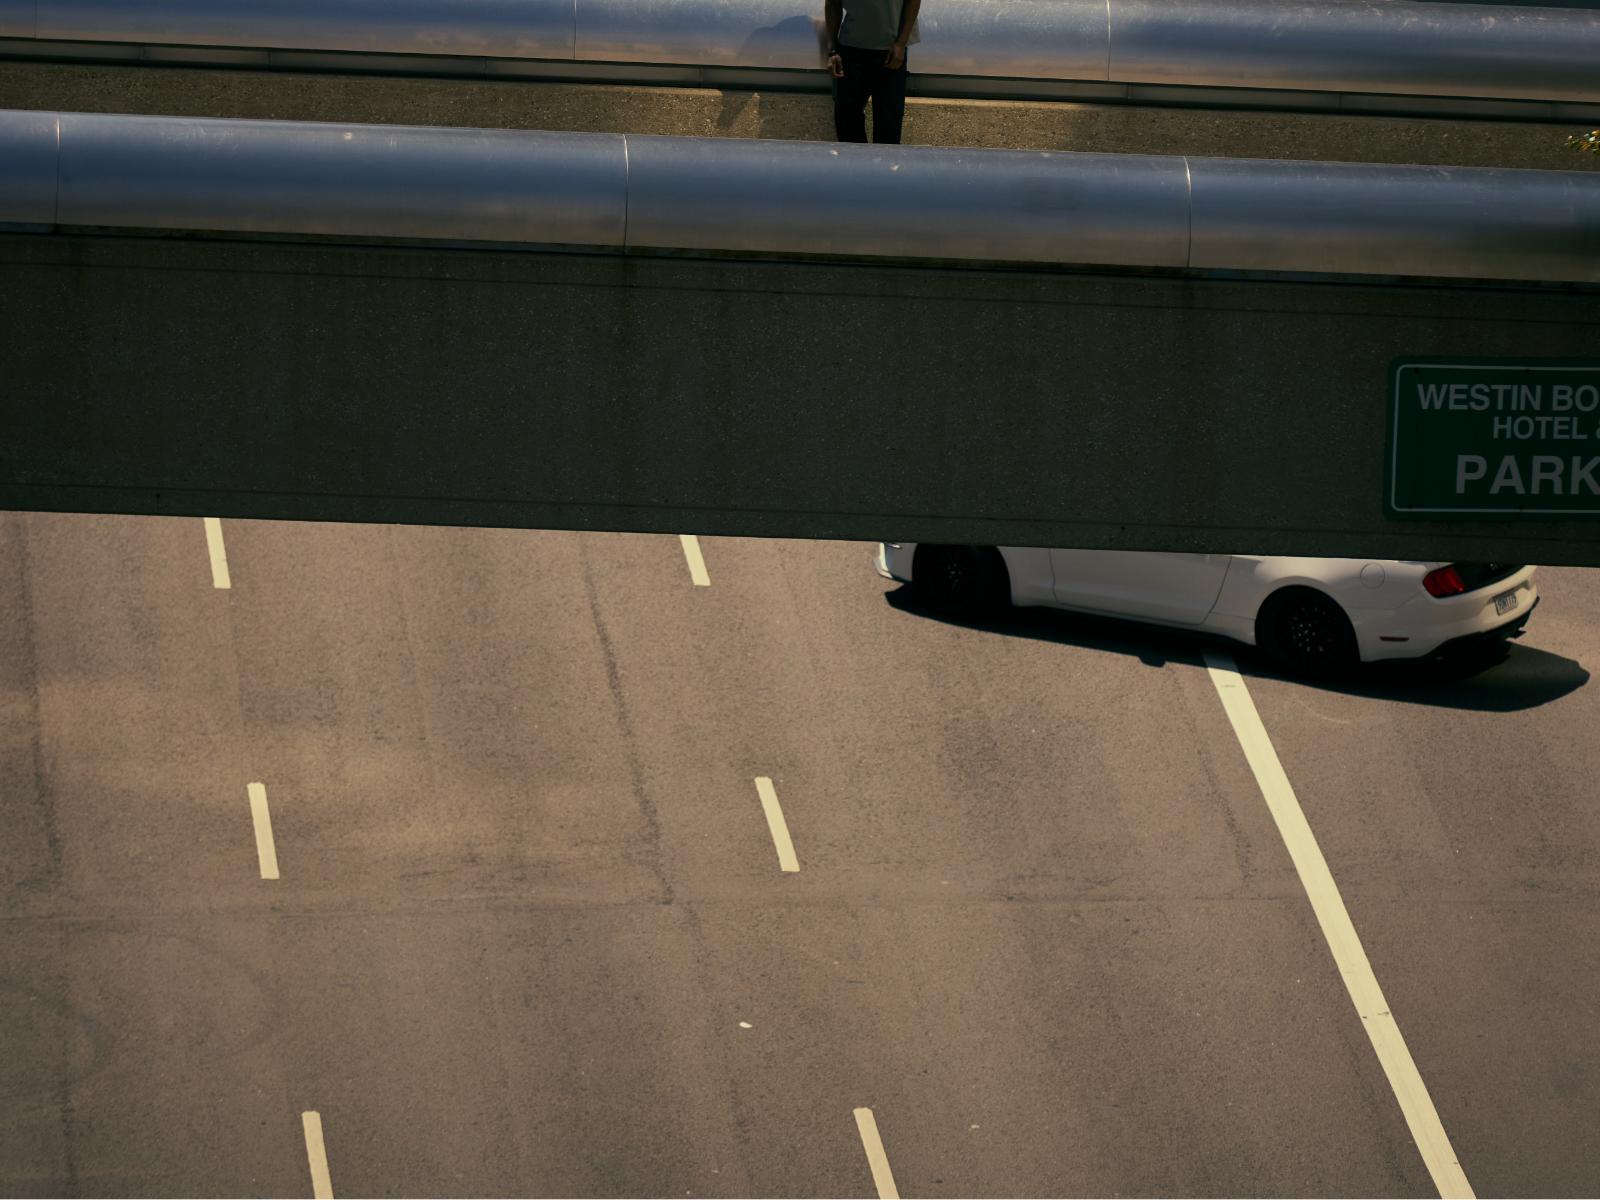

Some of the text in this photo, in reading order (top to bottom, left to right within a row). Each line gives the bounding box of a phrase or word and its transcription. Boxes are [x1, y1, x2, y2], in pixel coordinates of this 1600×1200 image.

[1417, 383, 1543, 411] WESTIN
[1492, 415, 1588, 440] HOTEL
[1455, 454, 1600, 495] PARK
